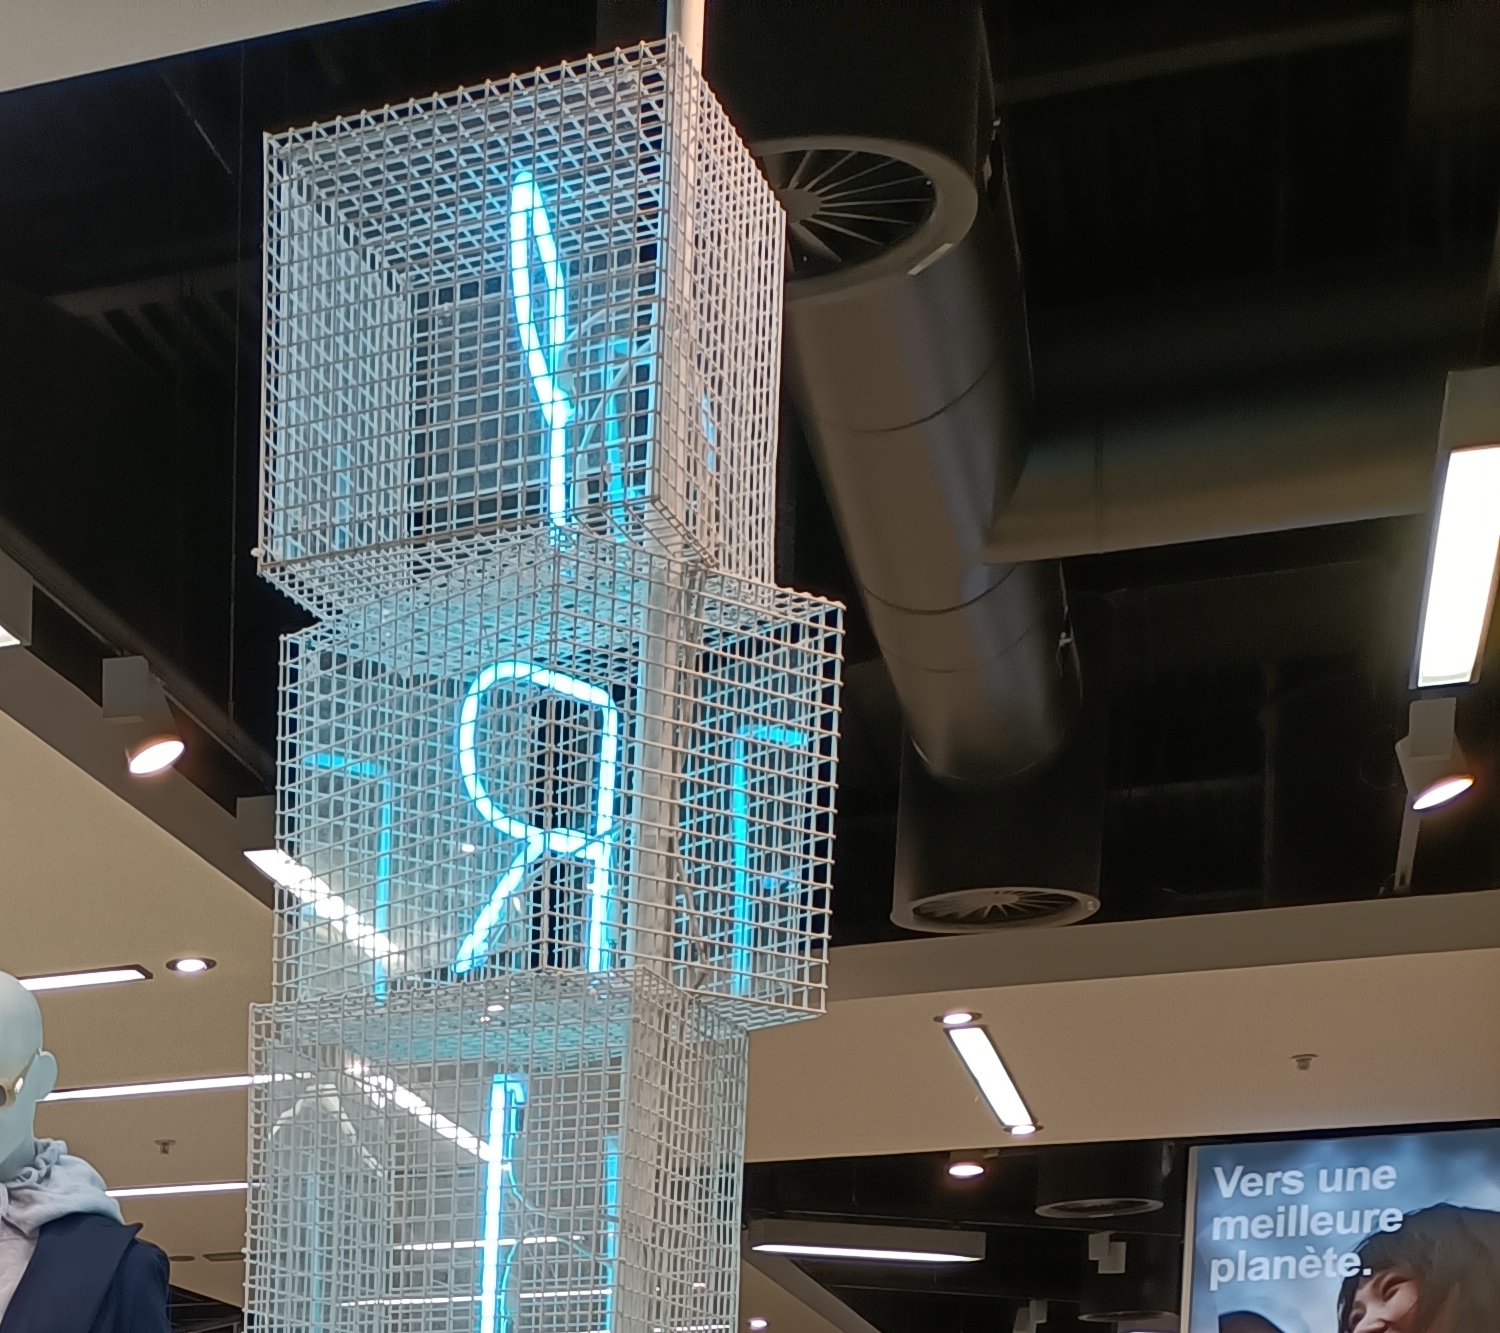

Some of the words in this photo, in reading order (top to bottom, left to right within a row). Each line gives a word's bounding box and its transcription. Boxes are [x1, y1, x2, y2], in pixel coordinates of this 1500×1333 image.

[1213, 1165, 1304, 1198] Vers
[1319, 1164, 1397, 1193] une
[1212, 1204, 1404, 1240] meilleure
[1210, 1246, 1372, 1291] planète.
